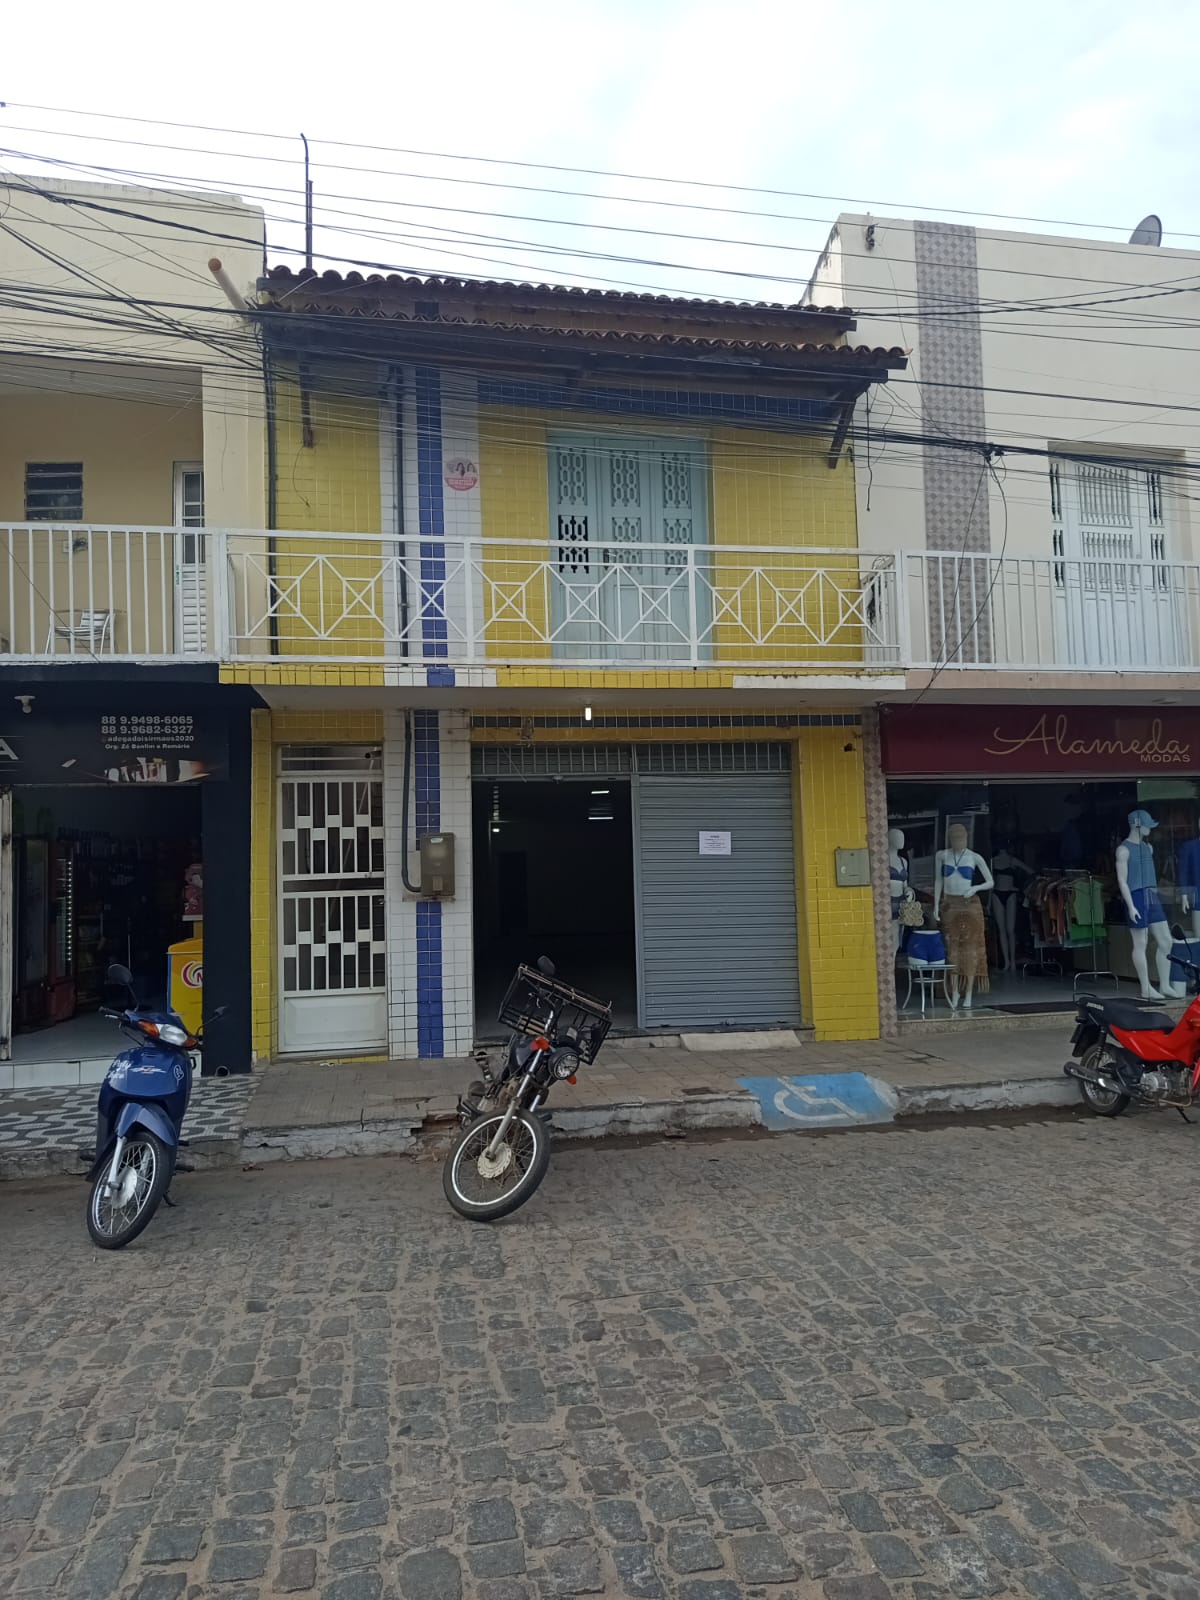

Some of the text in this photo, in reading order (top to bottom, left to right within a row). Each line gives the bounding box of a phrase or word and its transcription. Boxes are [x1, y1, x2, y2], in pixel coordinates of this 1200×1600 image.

[101, 715, 193, 724] 88 9.9498-6065
[101, 725, 193, 734] 88 9.9682-6327
[984, 713, 1189, 755] Alameda
[1140, 754, 1191, 763] MODAS
